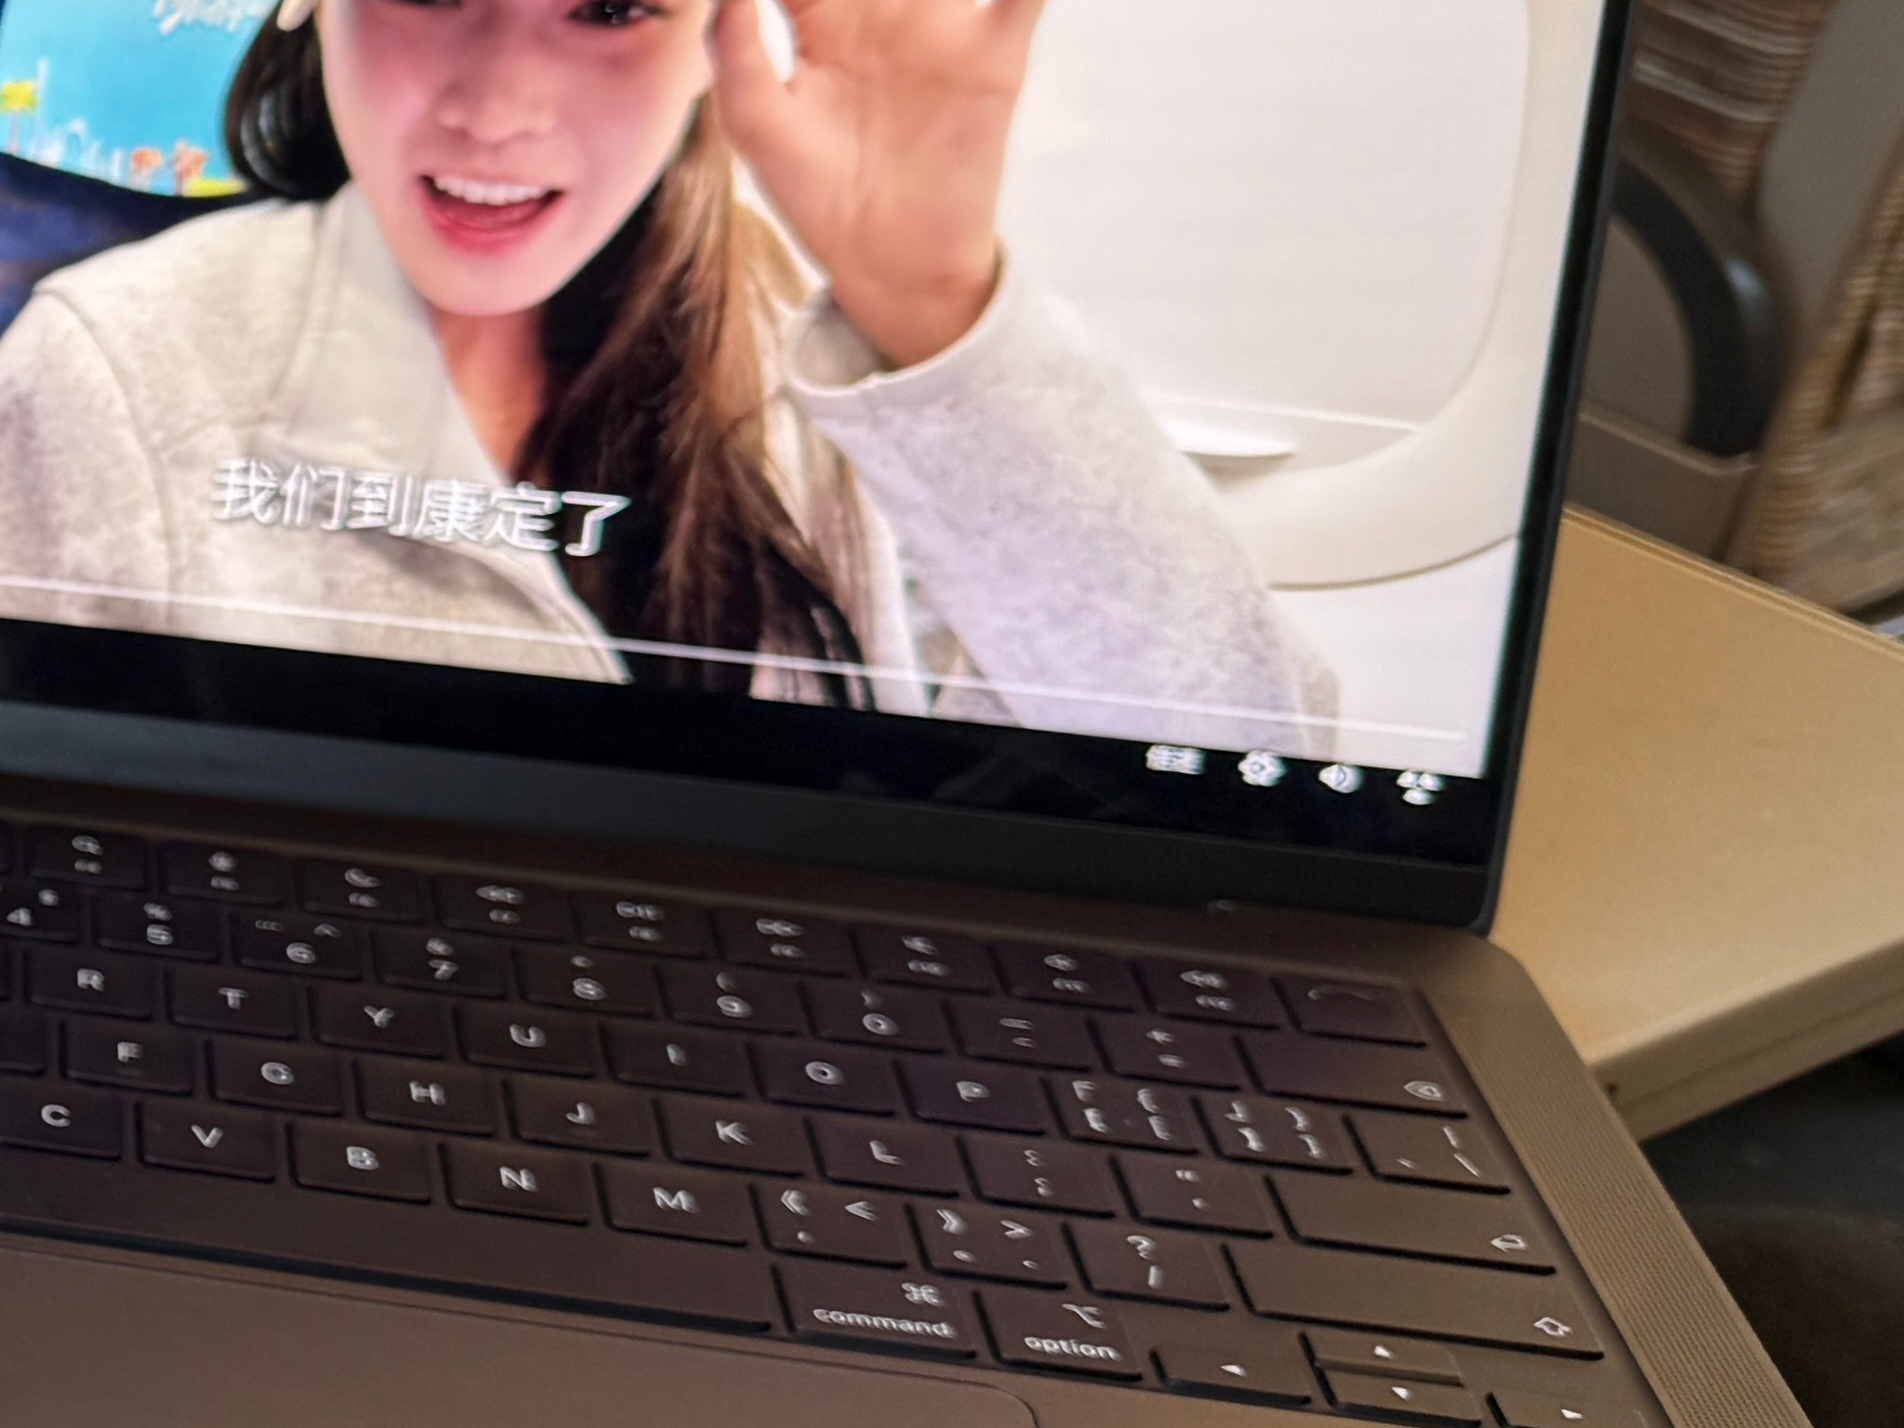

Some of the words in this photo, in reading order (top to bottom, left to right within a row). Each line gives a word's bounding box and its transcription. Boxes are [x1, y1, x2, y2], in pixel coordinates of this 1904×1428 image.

[212, 456, 630, 557] 我们到康定了
[6, 907, 31, 926] 4
[76, 968, 104, 990] R
[218, 987, 244, 1008] T
[363, 1006, 393, 1027] Y
[509, 1024, 544, 1048] U
[804, 1061, 839, 1085] O
[409, 1081, 444, 1104] H
[956, 1080, 985, 1102] P
[40, 1104, 70, 1128] C
[566, 1102, 592, 1124] J
[191, 1125, 222, 1148] V
[715, 1121, 747, 1144] K
[346, 1146, 378, 1170] B
[869, 1140, 900, 1165] L
[499, 1166, 535, 1191] N
[652, 1187, 692, 1211] M
[812, 1306, 956, 1338] command
[1024, 1336, 1119, 1360] option
